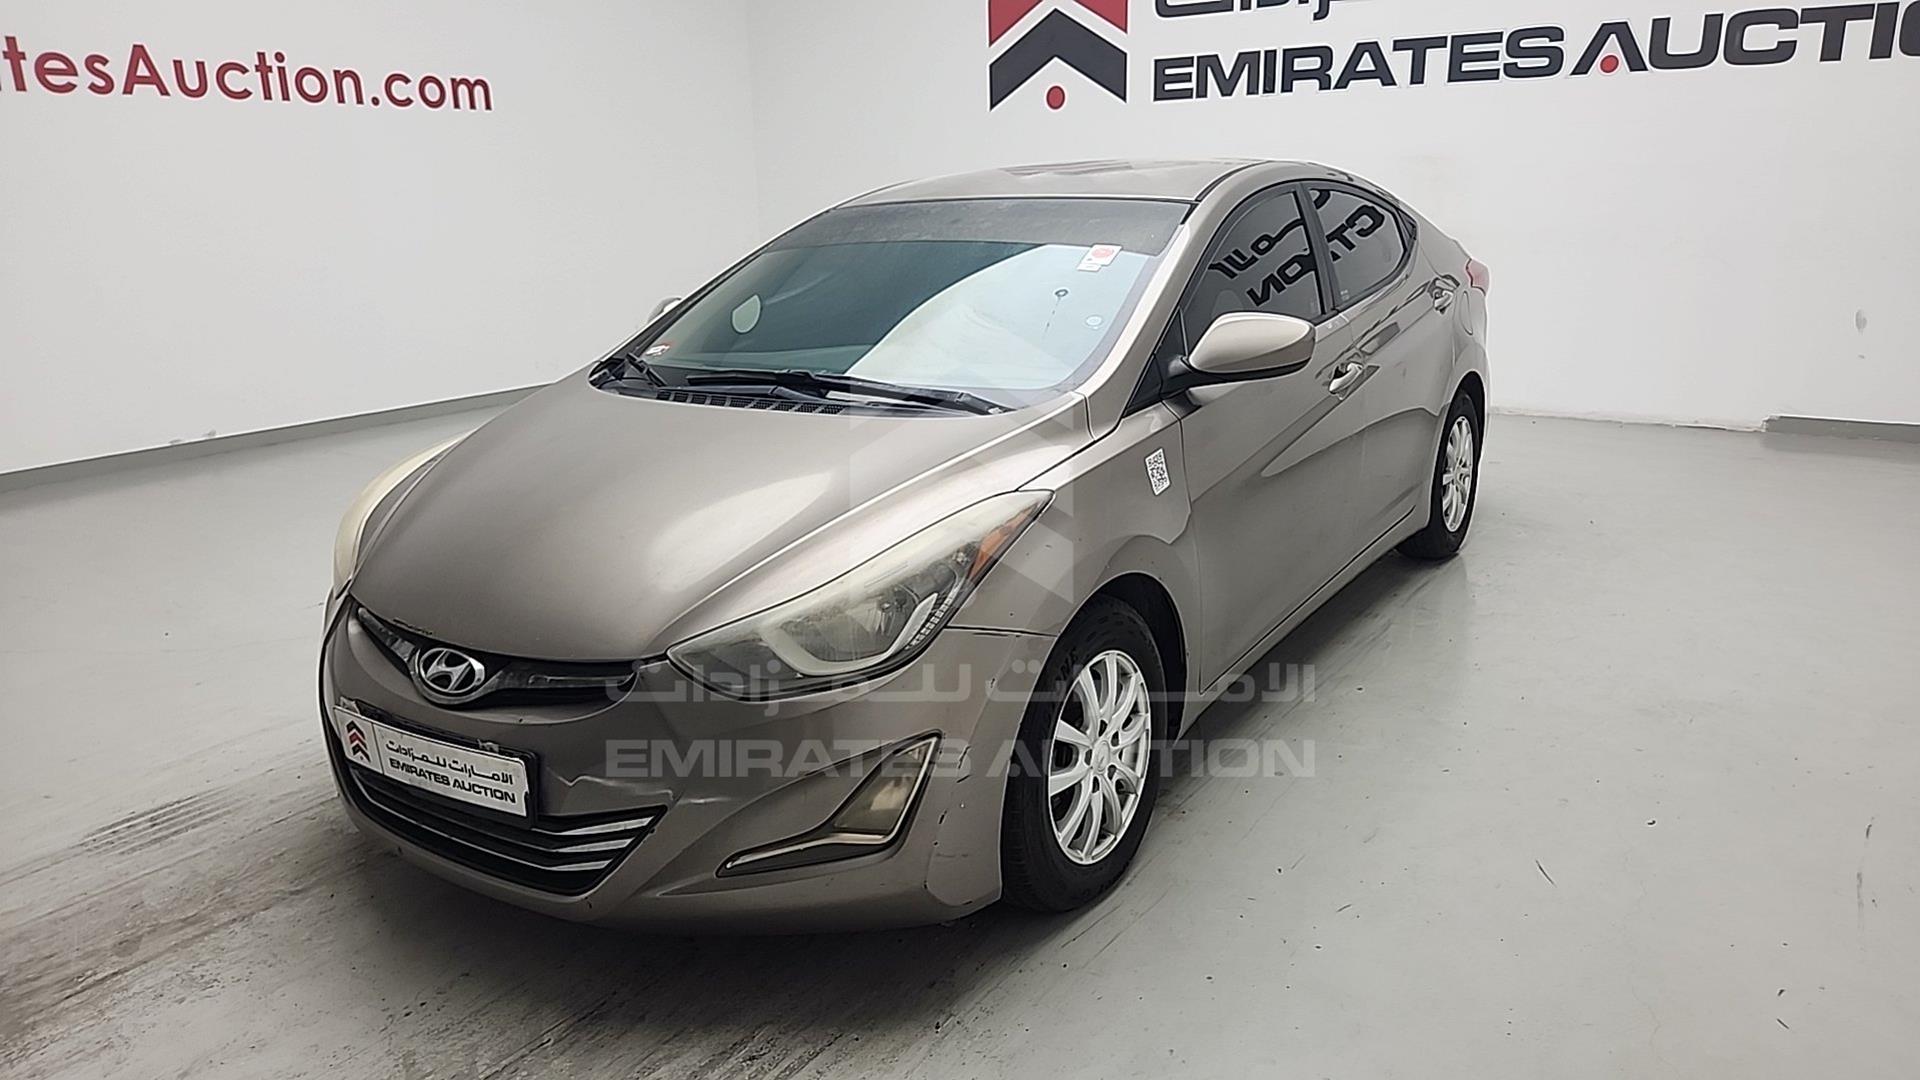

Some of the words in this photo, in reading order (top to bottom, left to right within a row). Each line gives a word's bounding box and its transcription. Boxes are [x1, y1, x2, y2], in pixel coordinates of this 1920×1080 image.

[0, 36, 493, 111] tesAuction.com
[1153, 26, 1566, 101] EMIRATES
[389, 758, 450, 786] EMIRATES
[453, 778, 517, 804] AUCTION
